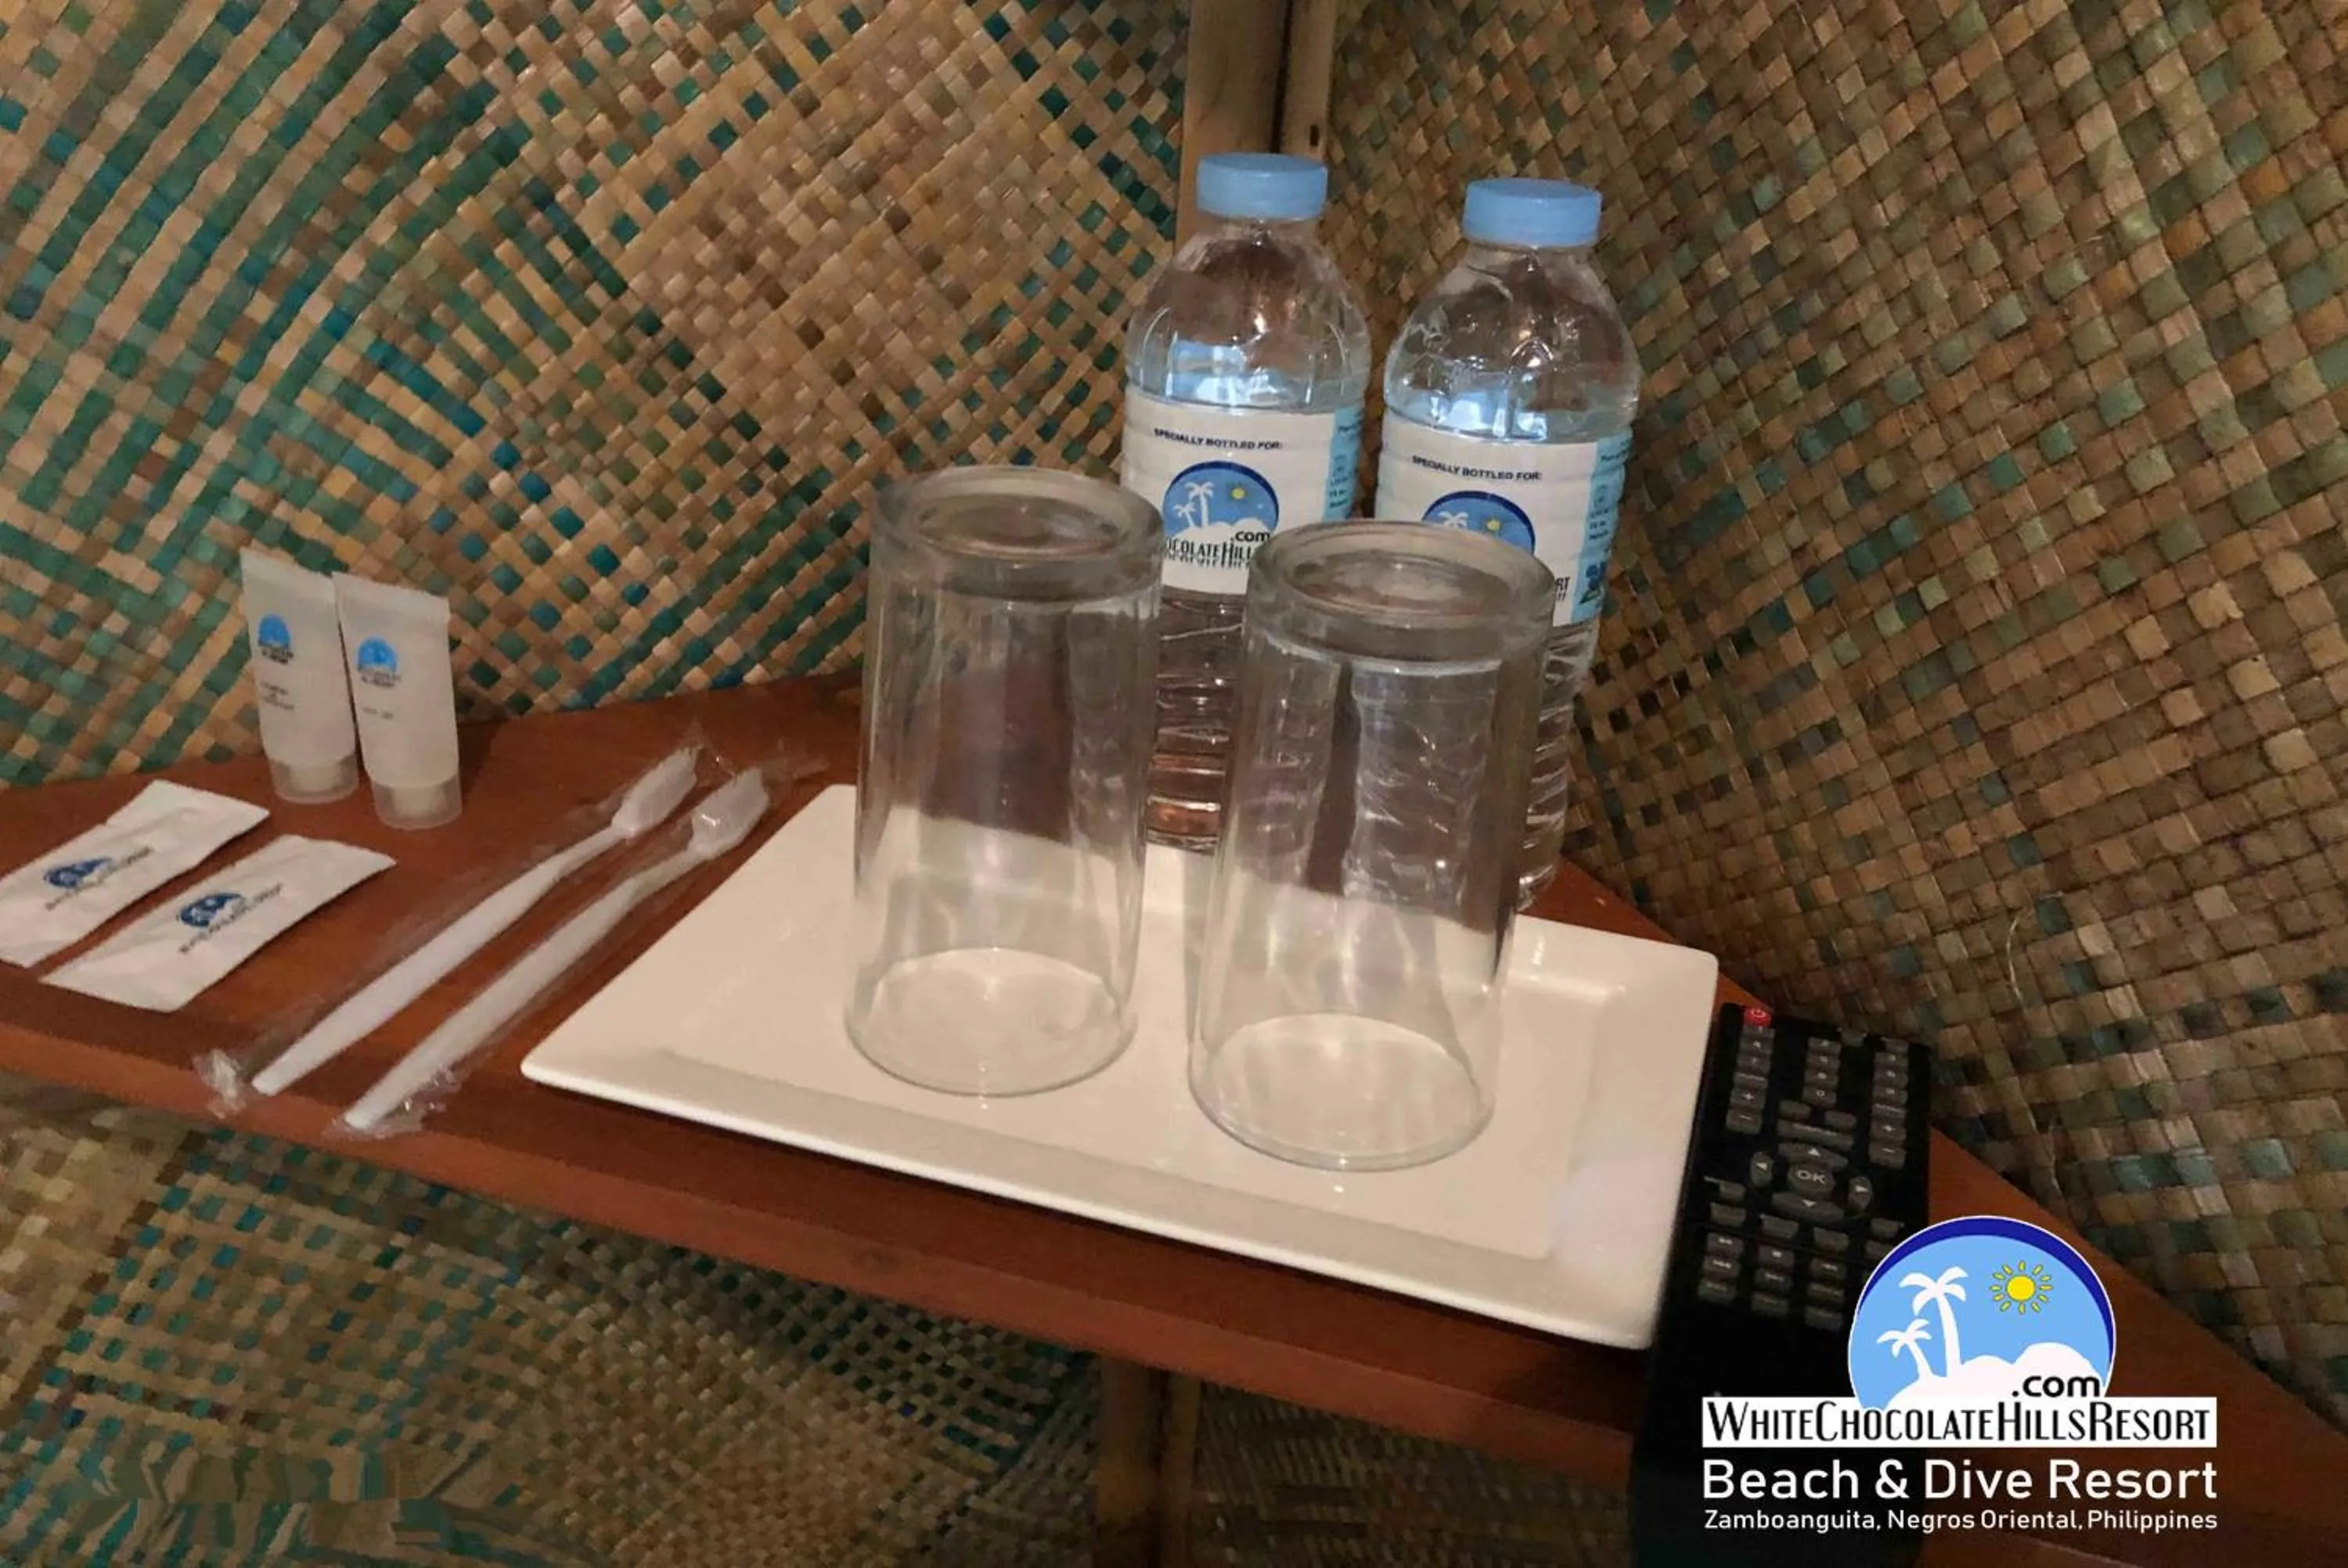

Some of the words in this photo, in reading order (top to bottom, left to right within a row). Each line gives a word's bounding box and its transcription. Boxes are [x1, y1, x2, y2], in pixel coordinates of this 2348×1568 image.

[1154, 428, 1204, 446] SPECIALLY
[1205, 437, 1255, 450] BOTTLED
[1411, 454, 1460, 474] SPECIALLY
[1461, 467, 1514, 480] BOTTLED
[1164, 537, 1254, 567] OCOLATEHILL
[1796, 1170, 1827, 1185] OK
